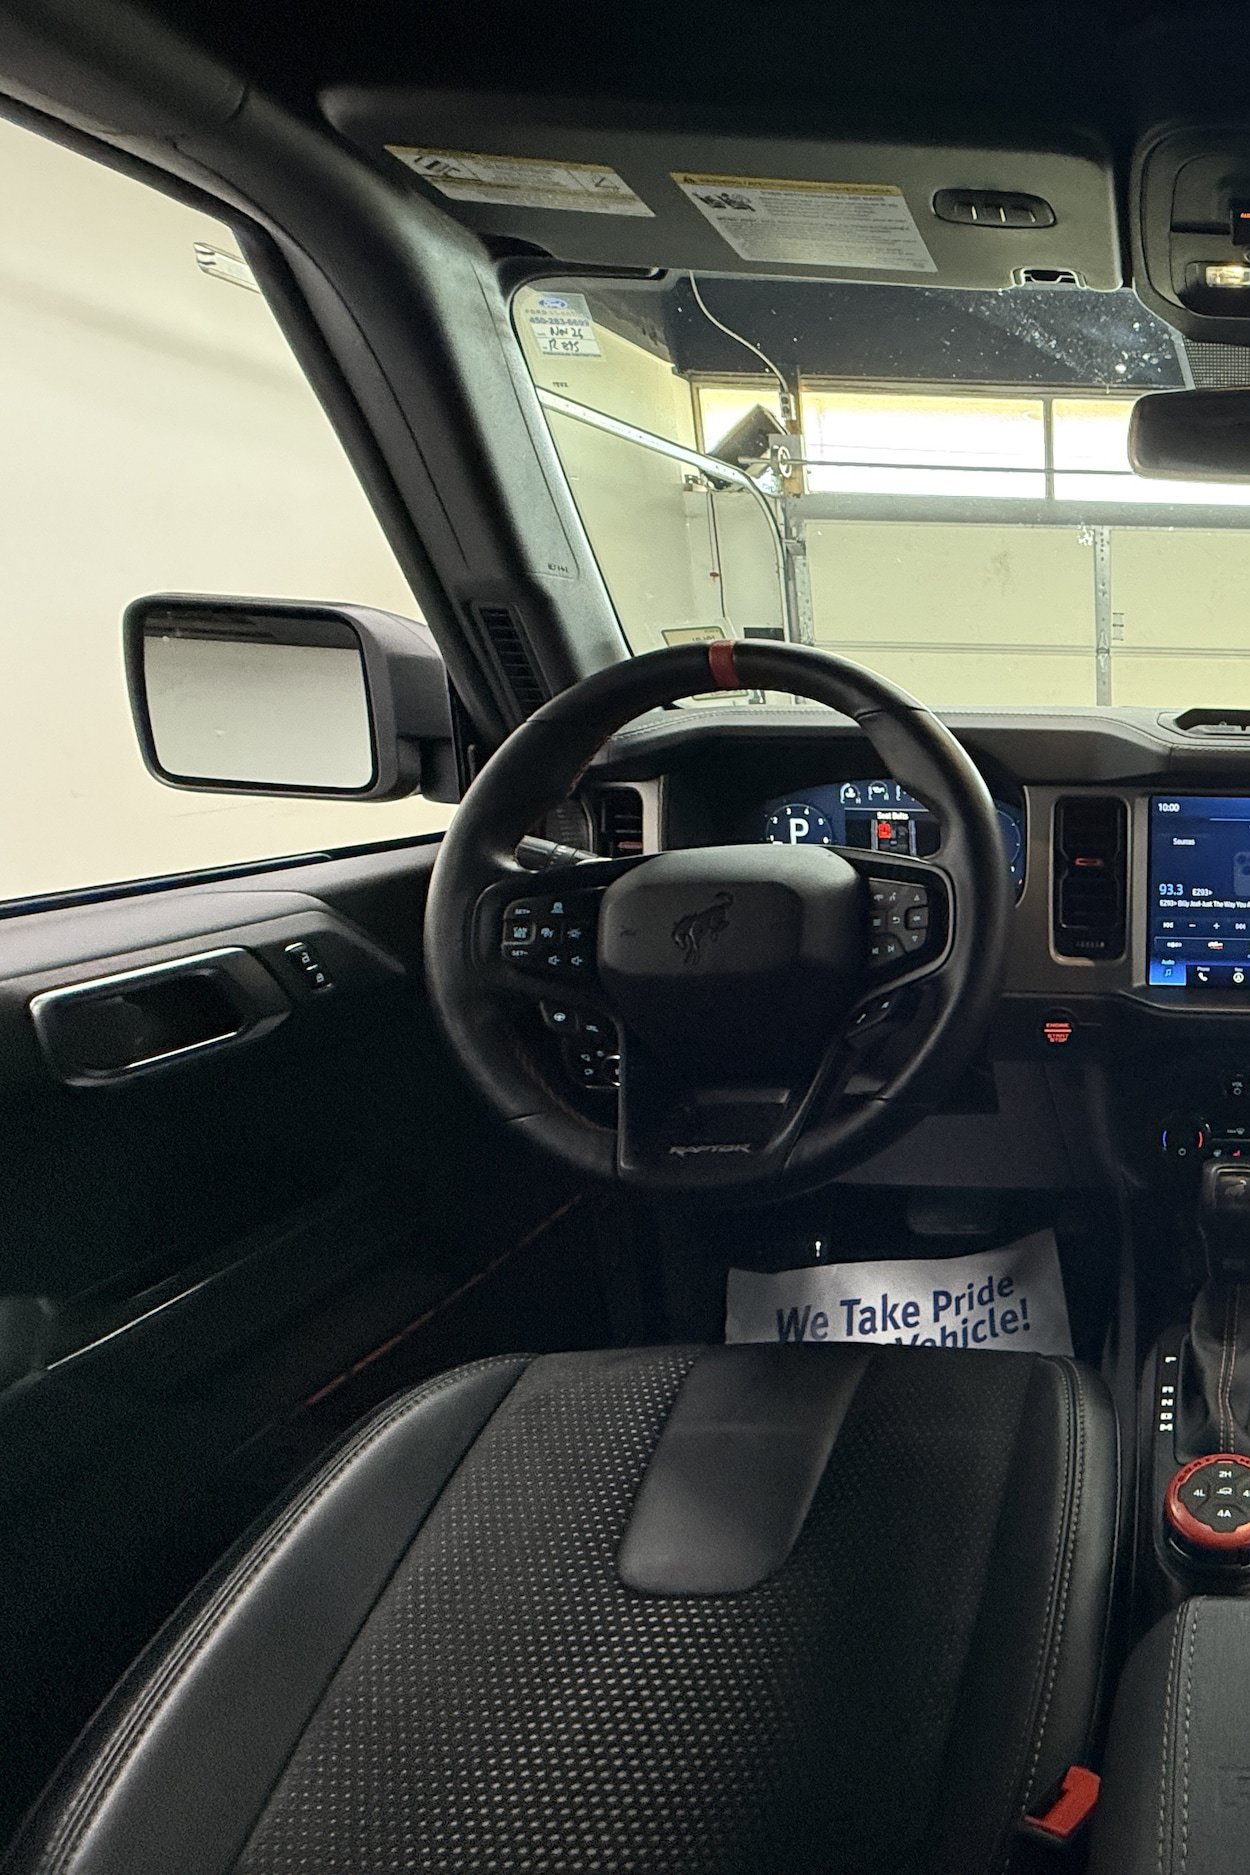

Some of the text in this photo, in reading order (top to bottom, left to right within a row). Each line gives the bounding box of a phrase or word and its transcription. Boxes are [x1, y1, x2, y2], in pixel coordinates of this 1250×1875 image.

[1158, 803, 1180, 812] 10:00
[789, 818, 810, 845] P
[1158, 883, 1183, 896] 93.3
[776, 1275, 1015, 1343] We Take Pride
[1217, 1510, 1231, 1518] 4A
